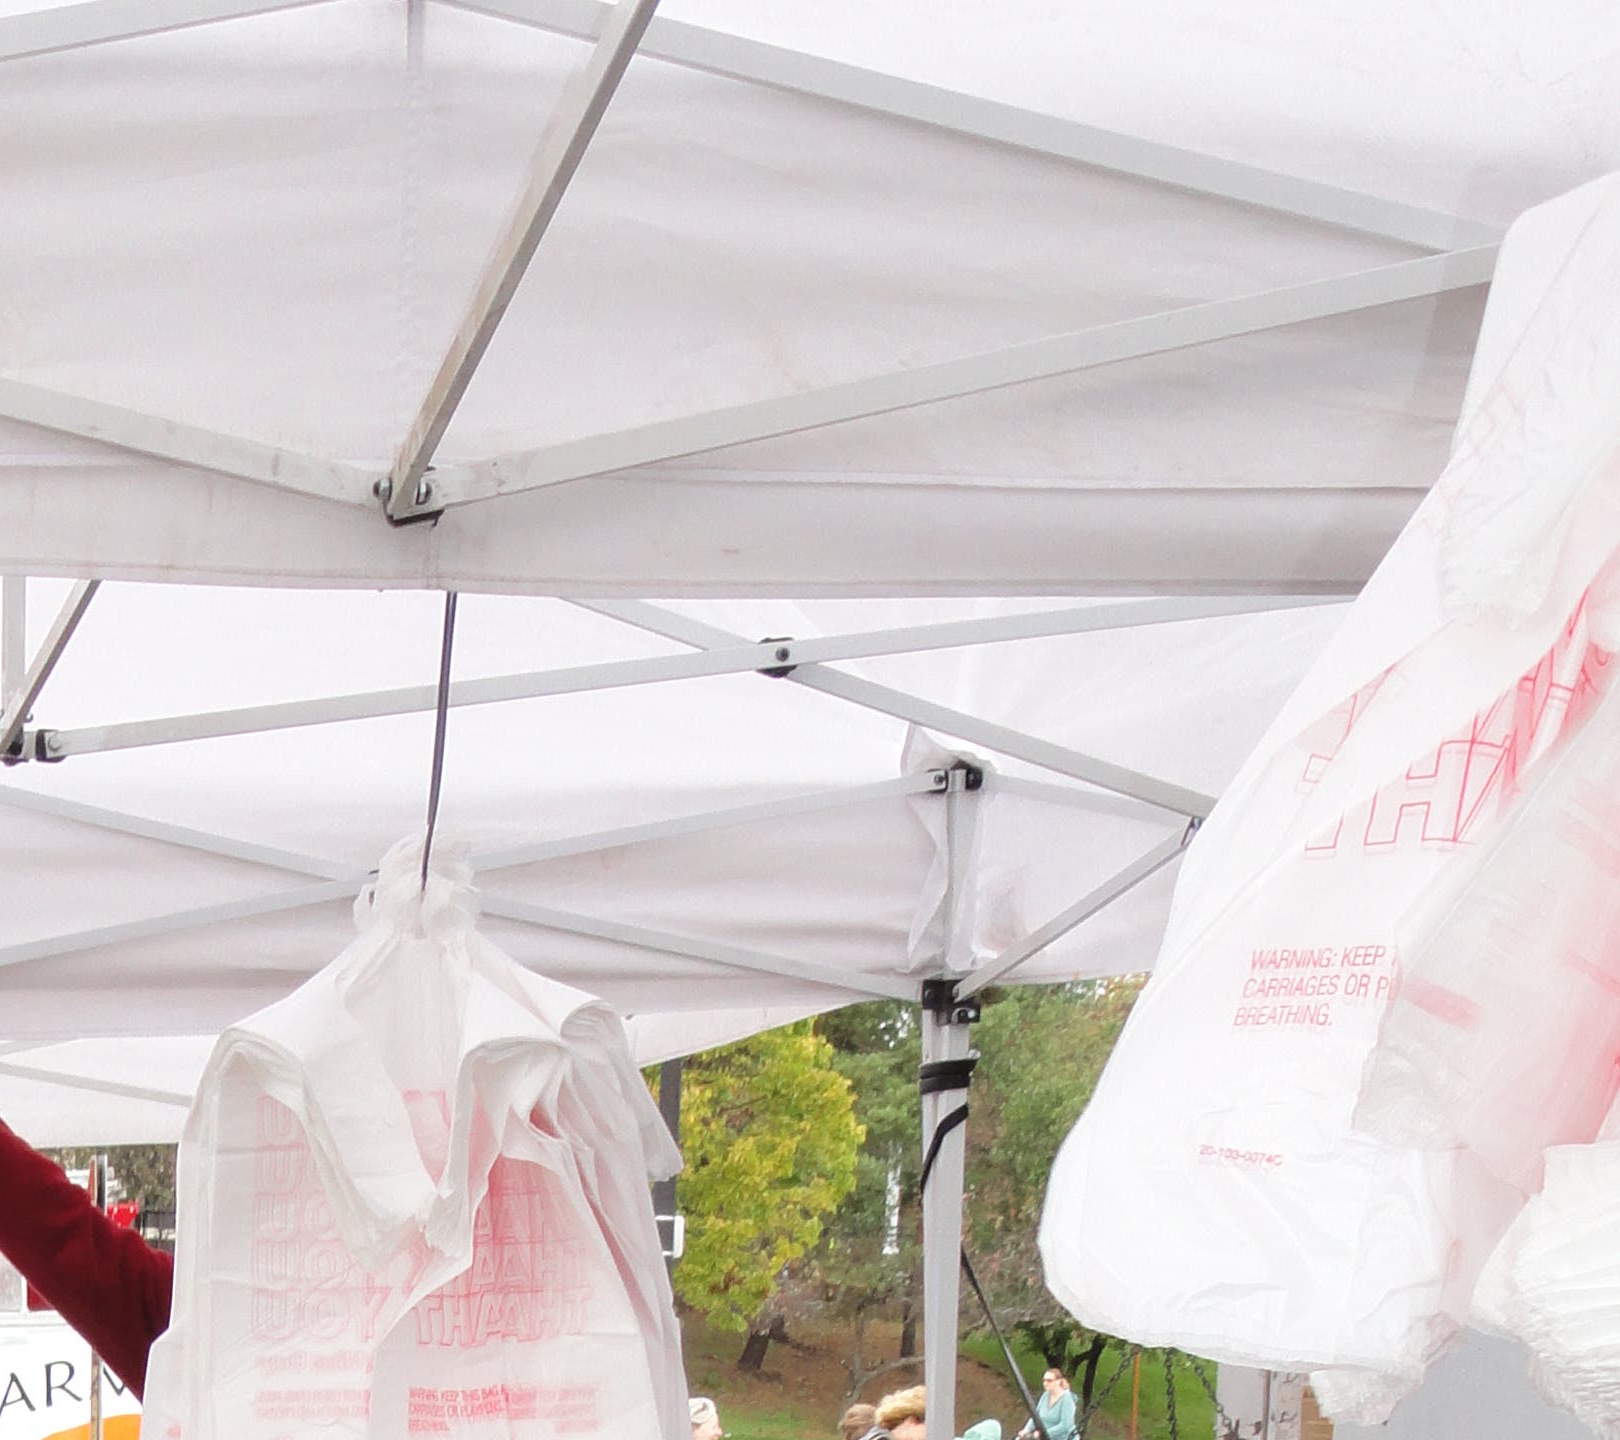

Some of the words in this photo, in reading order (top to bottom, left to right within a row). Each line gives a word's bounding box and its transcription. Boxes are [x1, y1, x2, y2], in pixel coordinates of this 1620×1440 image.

[1251, 947, 1337, 970] WARNING:
[1341, 944, 1386, 968] KEEP
[1242, 974, 1340, 998] CARRIAGES
[1344, 973, 1371, 998] OR
[1233, 1003, 1333, 1026] BREATHING.
